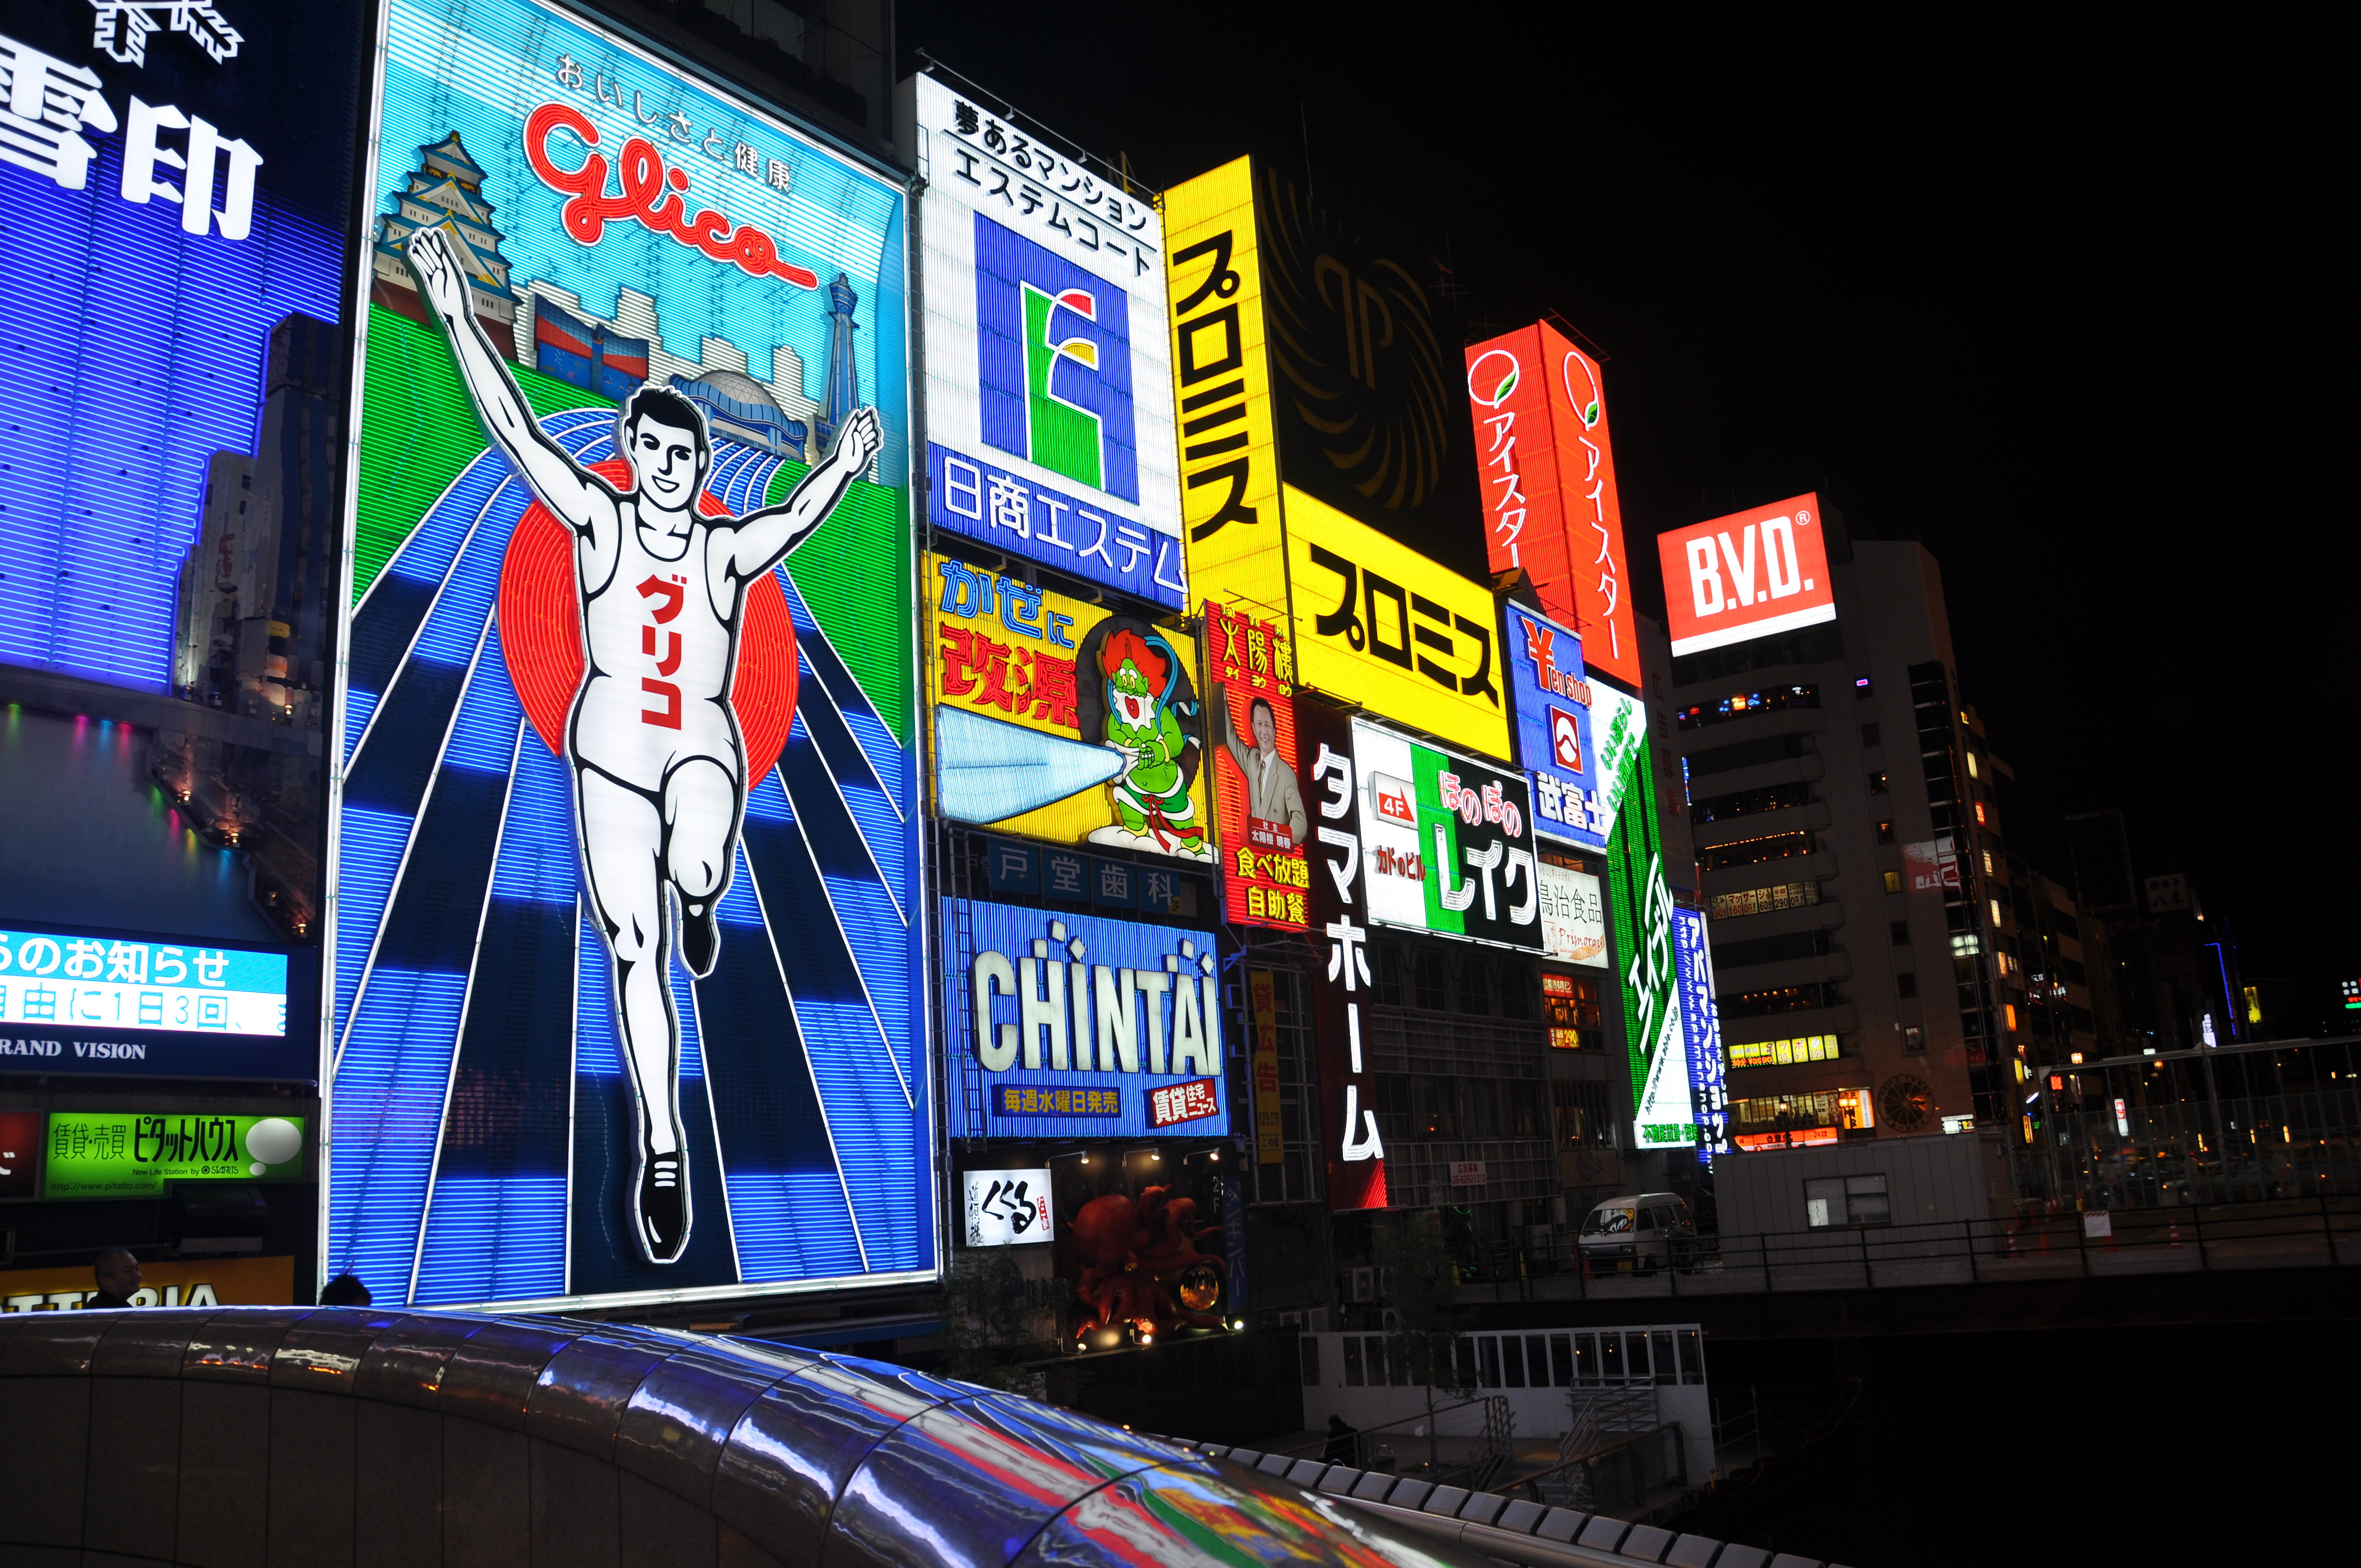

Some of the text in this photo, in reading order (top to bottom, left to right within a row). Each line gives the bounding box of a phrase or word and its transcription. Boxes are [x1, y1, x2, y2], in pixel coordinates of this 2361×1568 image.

[0, 34, 263, 241] 雪印
[557, 53, 791, 195] おいしさと健康
[524, 100, 819, 291] Glico
[955, 100, 1146, 230] 夢あるマンション
[956, 148, 1150, 276] エステムコート
[1173, 230, 1258, 544] プロミス
[945, 456, 1188, 593] 日商エステム
[1484, 412, 1526, 568] アイスター
[1579, 436, 1618, 659] アイスター
[941, 559, 1074, 649] かぜに
[1309, 542, 1499, 709] プロミス
[635, 574, 687, 731] グリコ
[942, 622, 1080, 729] 改源
[1566, 672, 1593, 709] shop
[1384, 798, 1404, 816] 4F
[1439, 770, 1521, 838] ほのぼの
[1538, 771, 1607, 836] 武富士
[1000, 847, 1172, 906] 戸堂歯科
[1237, 846, 1310, 889] 食べ放題
[1376, 845, 1426, 881] カドのビル
[1435, 823, 1537, 926] レイク
[1172, 900, 1180, 912] 3F
[1248, 885, 1305, 924] 自助餐
[1313, 743, 1384, 1162] タマホーム
[1628, 851, 1673, 1055] エイブル
[0, 982, 242, 1031] 由に1日3回、
[1252, 982, 1279, 1093] 貸広告
[1564, 1029, 1577, 1044] 290
[1688, 917, 1727, 1154] アパマンショップ
[73, 1042, 146, 1059] VISION
[134, 1116, 239, 1162] ピタットハウス
[1004, 1088, 1119, 1114] 毎週水曜日発売
[1188, 1097, 1217, 1116] ニュース
[191, 1168, 200, 1176] by
[981, 1180, 1037, 1234] くくる
[0, 1283, 219, 1313] TTRIA
